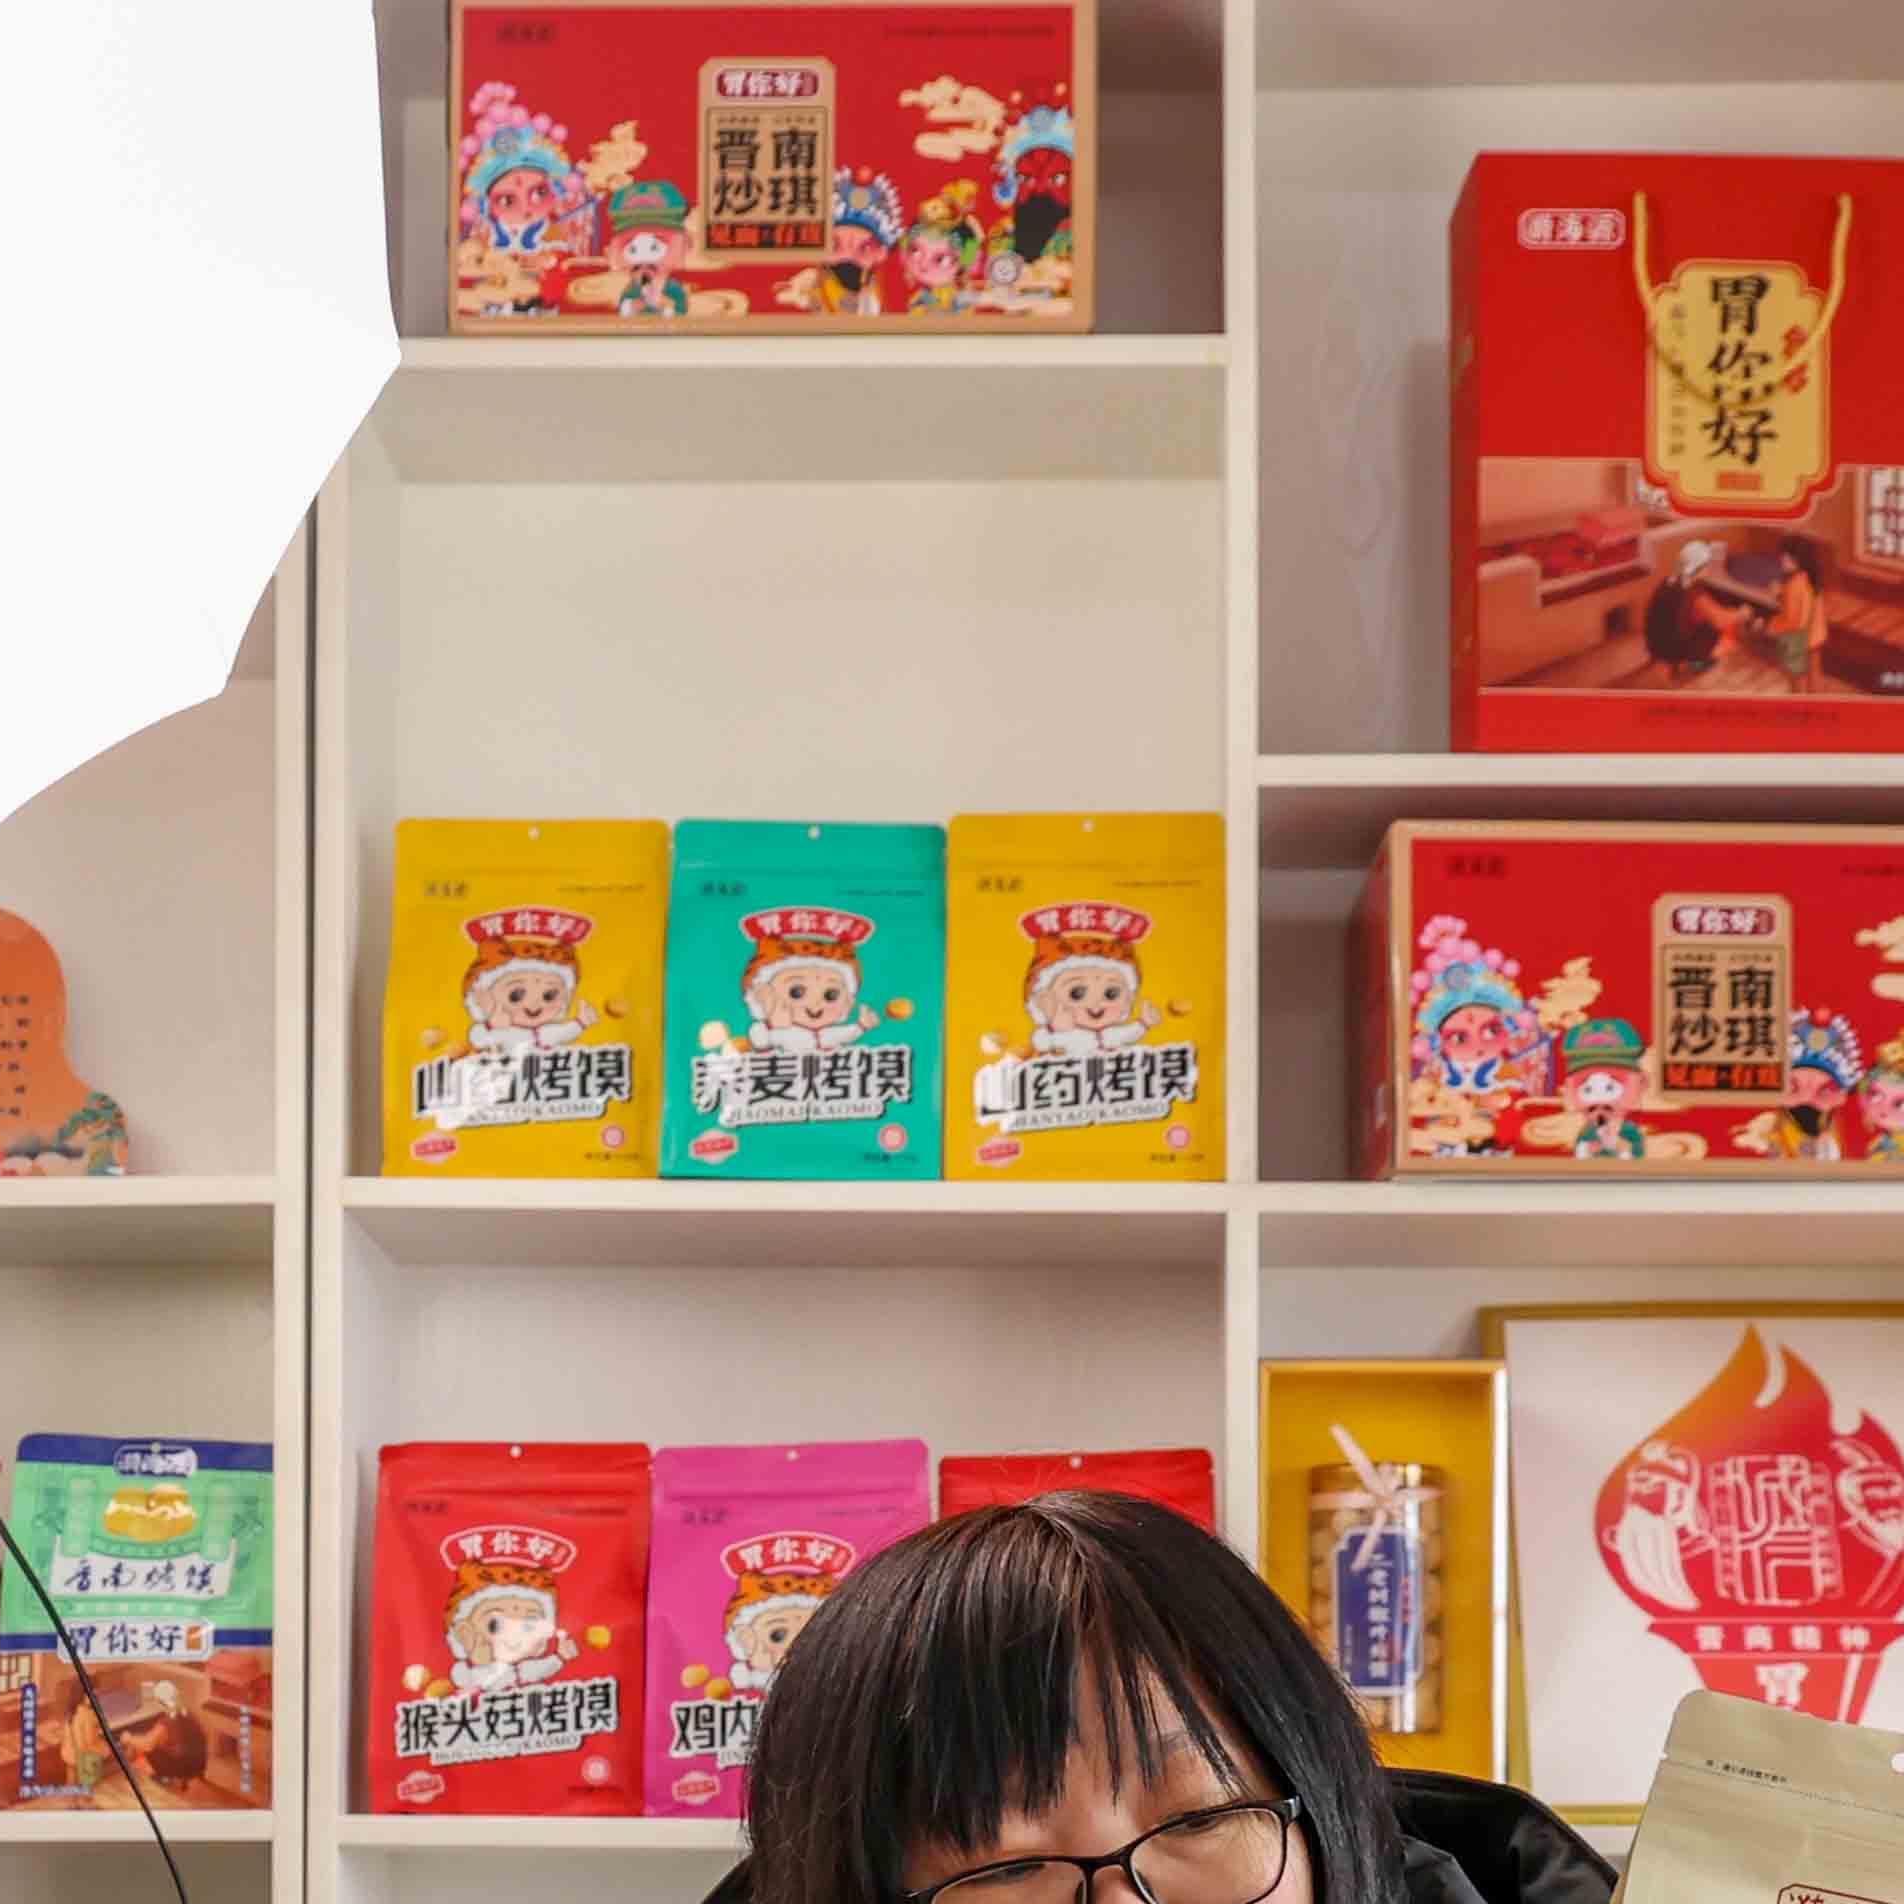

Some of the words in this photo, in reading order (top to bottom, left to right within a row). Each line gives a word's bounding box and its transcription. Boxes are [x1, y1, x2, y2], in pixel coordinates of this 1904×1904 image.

[715, 128, 817, 170] 晋南
[715, 176, 817, 214] 炒琪
[1701, 273, 1779, 465] 胃你好
[1668, 966, 1774, 1008] 晋南
[1669, 1018, 1775, 1057] 炒琪
[981, 1048, 1188, 1116] 山药烤馍
[458, 1531, 554, 1558] 胃你好
[68, 1624, 182, 1654] 胃你好
[1695, 1625, 1869, 1651] 晋商精神
[400, 1682, 612, 1751] 猴头菇烤馍
[674, 1702, 756, 1752] 鸡内
